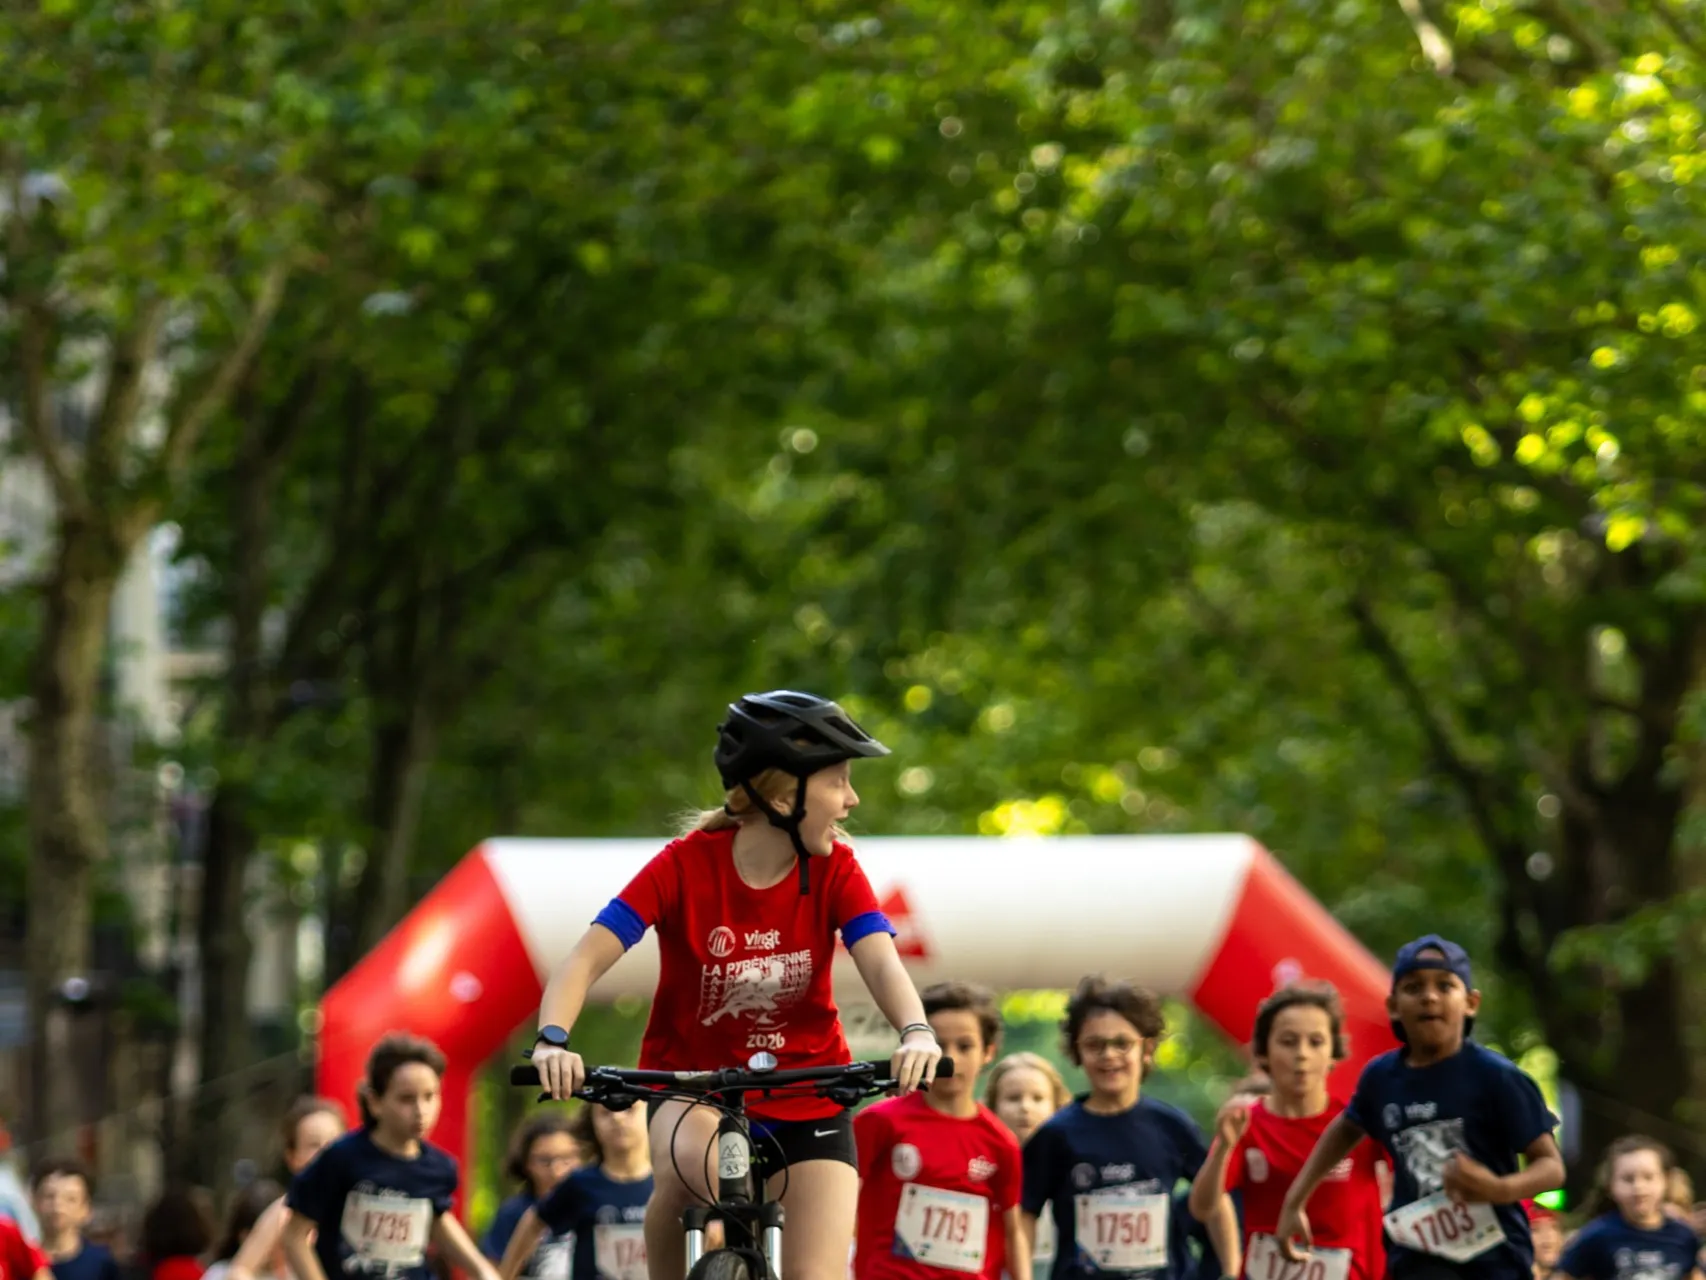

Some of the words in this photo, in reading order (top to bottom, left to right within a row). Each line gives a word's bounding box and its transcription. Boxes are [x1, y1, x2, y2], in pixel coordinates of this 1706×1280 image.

[702, 964, 721, 976] LA
[745, 1032, 786, 1051] 2026
[922, 1205, 970, 1244] 1719
[1095, 1210, 1150, 1245] 1750
[1411, 1200, 1475, 1252] 1703
